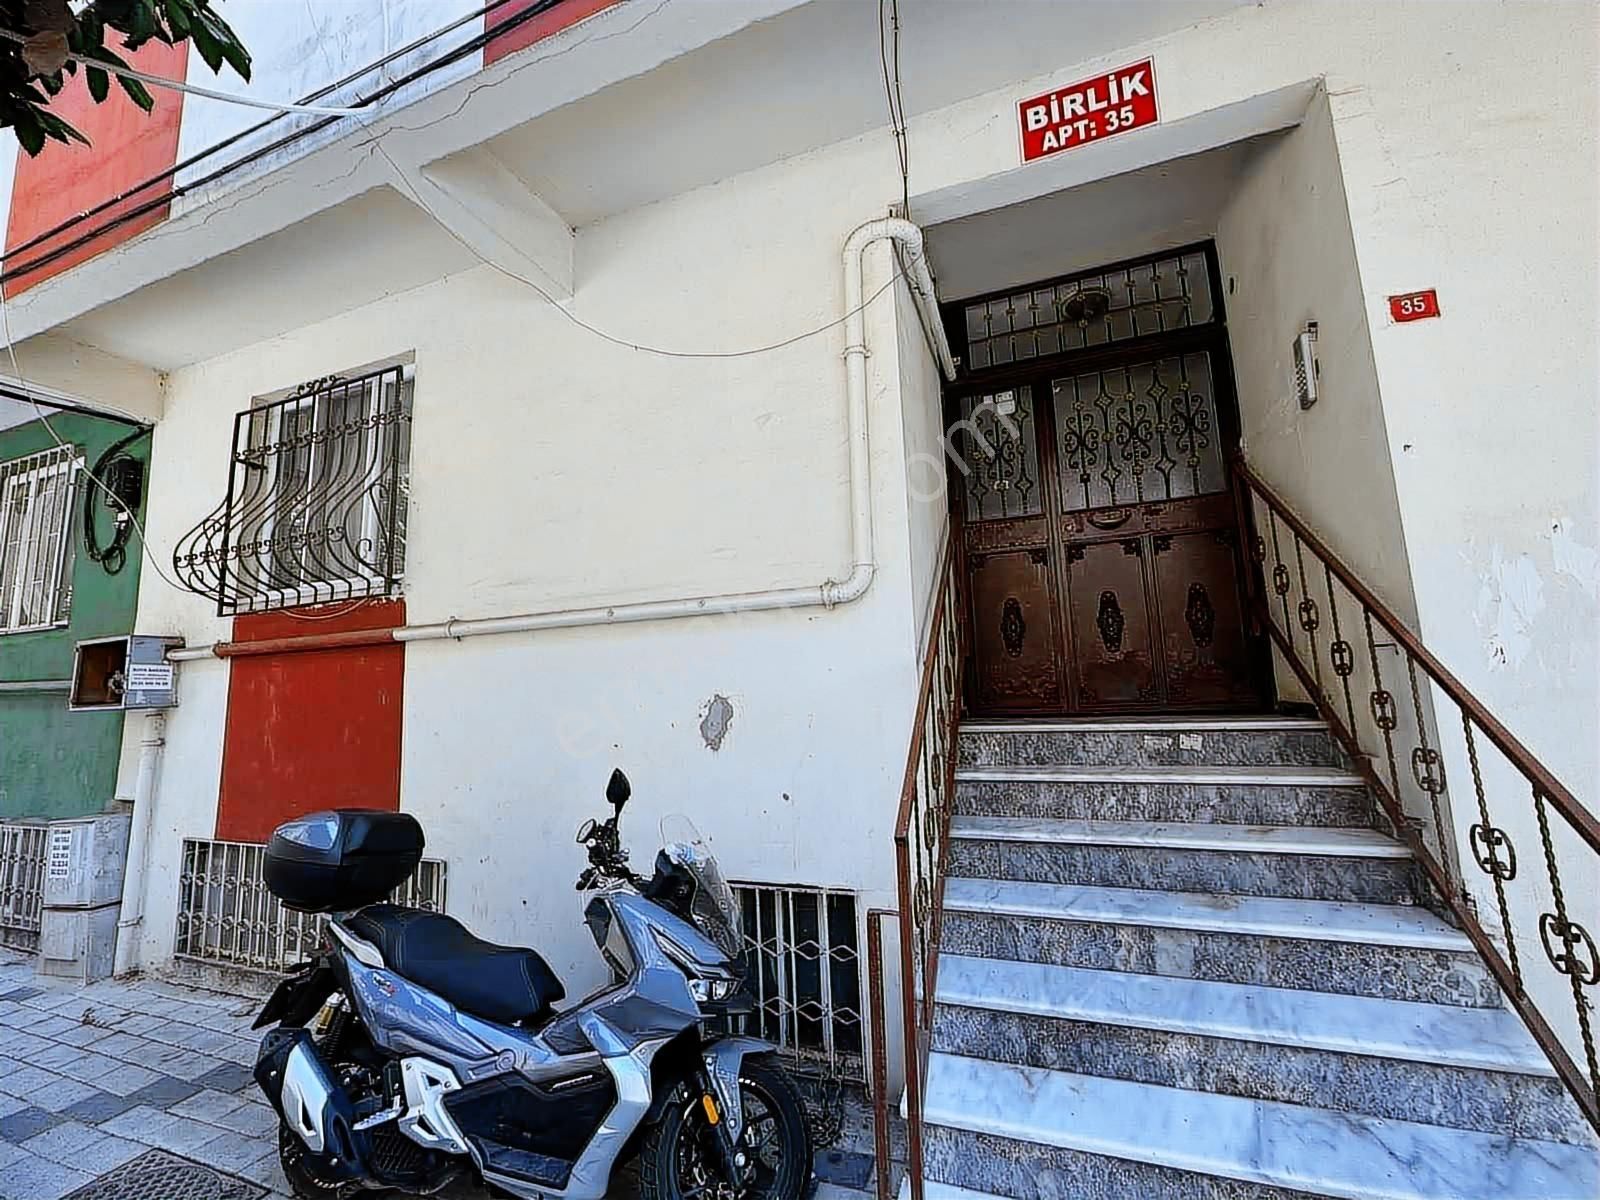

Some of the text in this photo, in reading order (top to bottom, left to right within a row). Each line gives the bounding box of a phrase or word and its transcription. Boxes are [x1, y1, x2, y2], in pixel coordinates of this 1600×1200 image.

[1026, 70, 1149, 132] BİRLİK
[1042, 105, 1135, 151] APT: 35
[1400, 296, 1425, 315] 35
